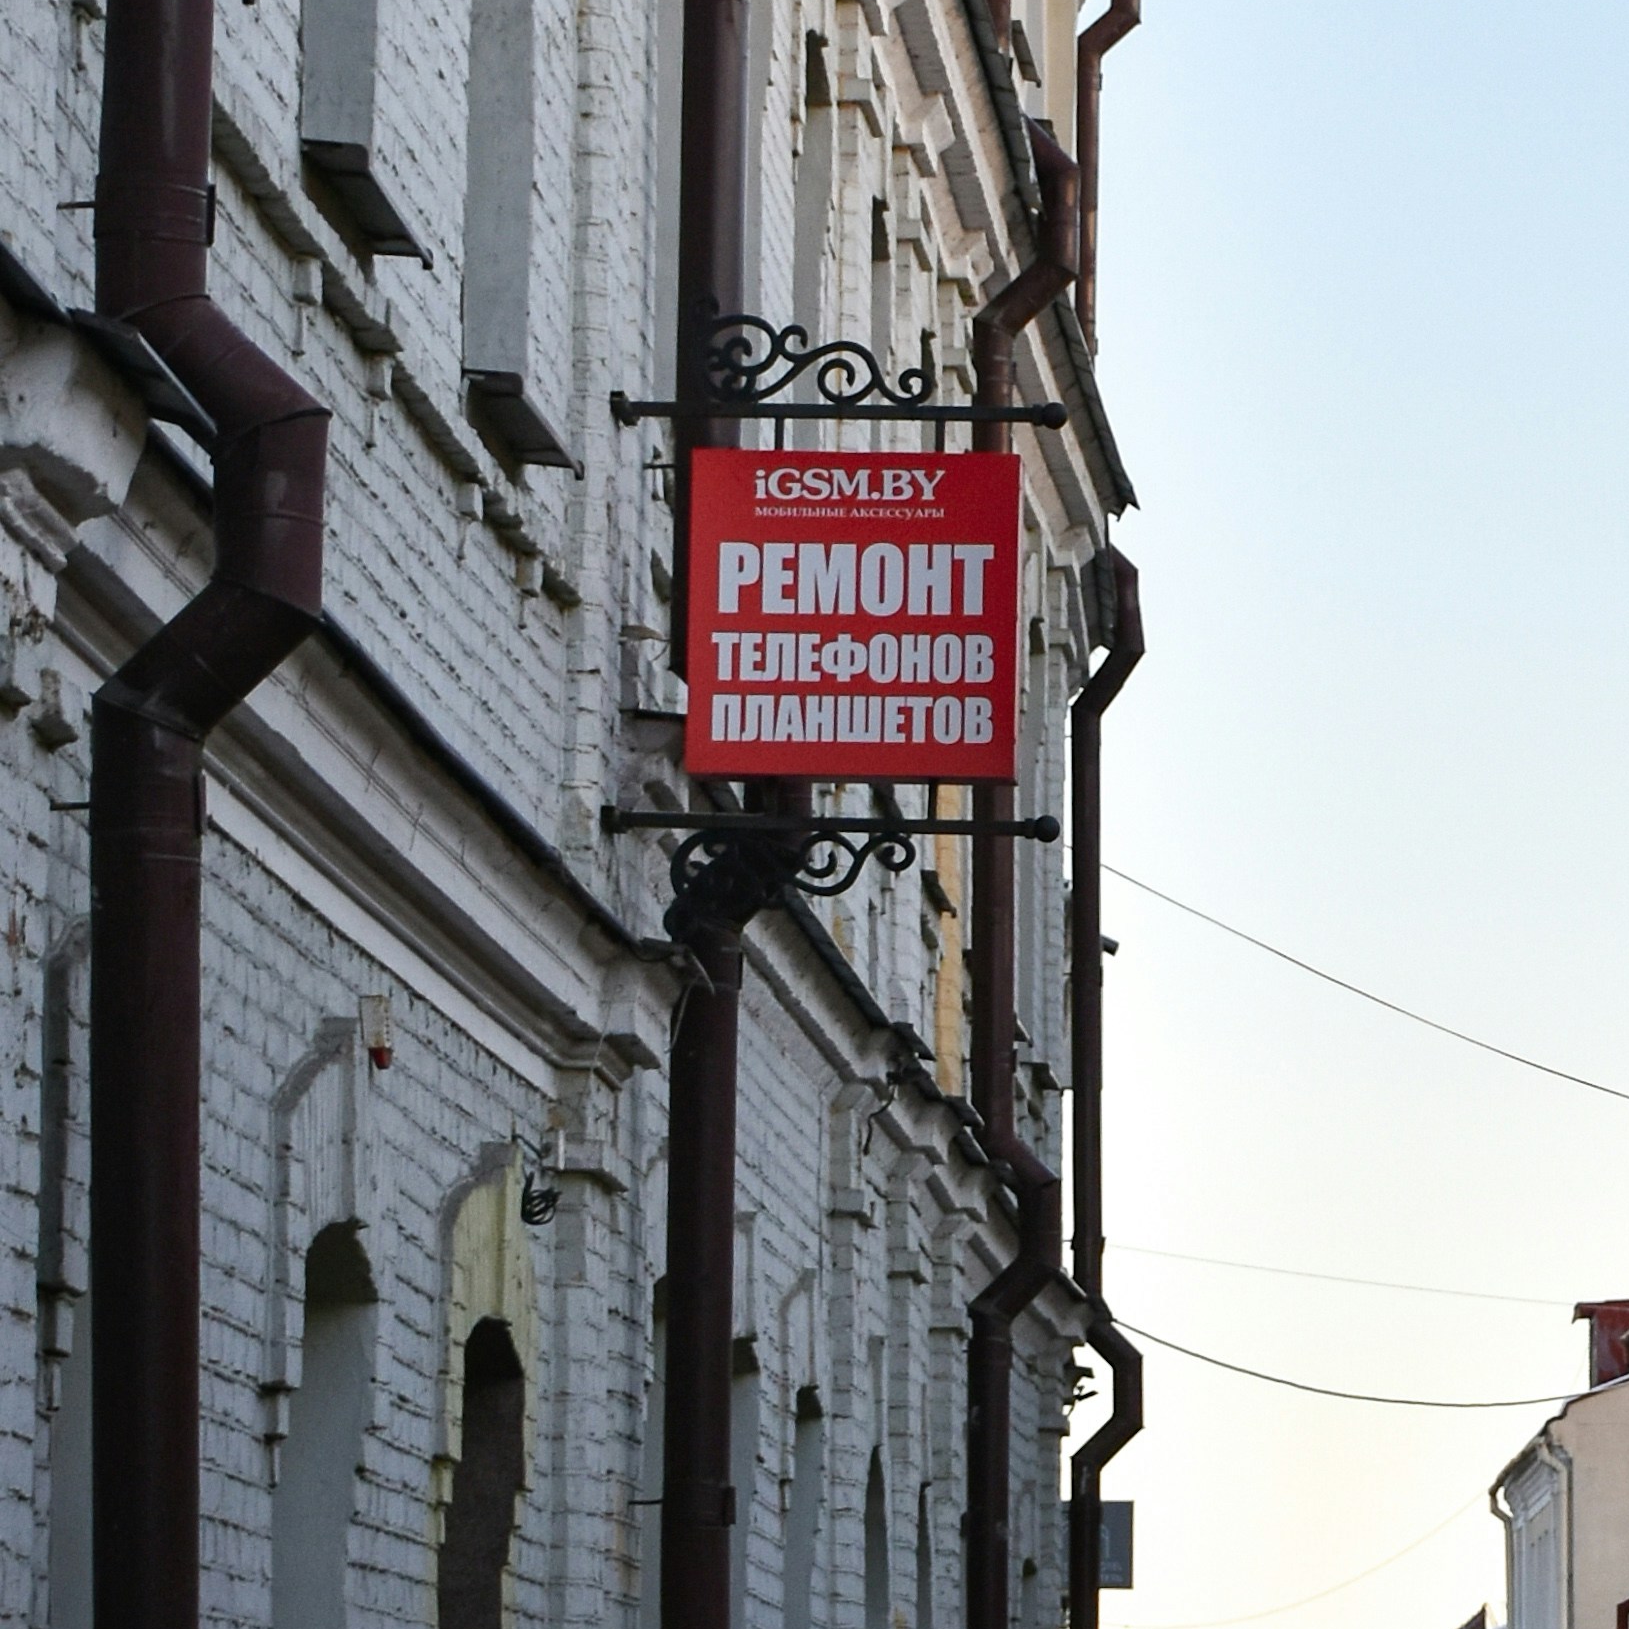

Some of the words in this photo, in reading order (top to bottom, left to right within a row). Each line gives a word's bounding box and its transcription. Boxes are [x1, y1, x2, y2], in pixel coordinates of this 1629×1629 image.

[755, 468, 945, 500] iGSM.BY
[754, 507, 846, 519] МОБИЛЬНЫЕ
[850, 508, 946, 521] АКСЕССУАРЫ
[718, 542, 994, 616] РЕМОНТ
[711, 632, 994, 683] ТЕЛЕФОНОВ
[711, 694, 993, 744] ПЛАНШЕТОВ
